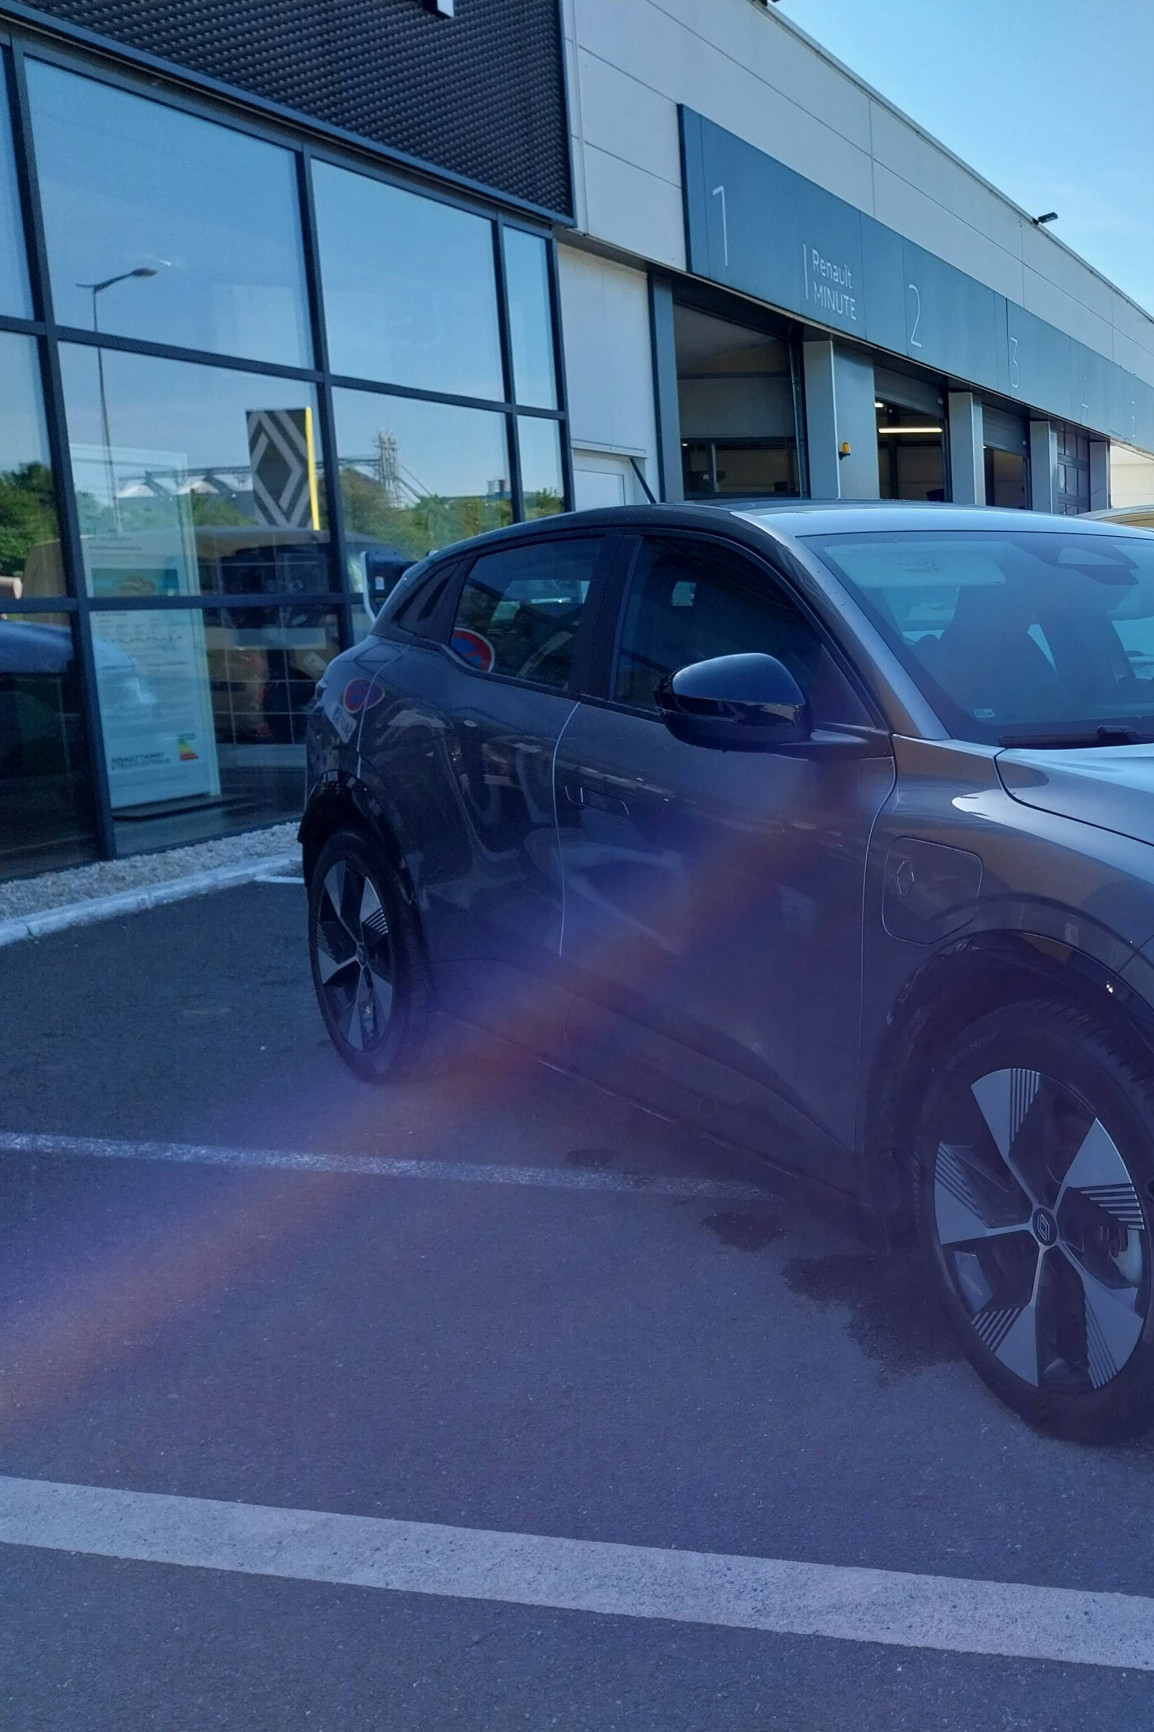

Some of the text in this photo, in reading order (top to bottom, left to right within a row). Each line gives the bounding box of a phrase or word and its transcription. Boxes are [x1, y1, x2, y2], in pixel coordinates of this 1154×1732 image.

[712, 185, 728, 266] 1
[812, 248, 852, 289] Renault
[813, 281, 857, 320] MINUTE
[909, 284, 922, 348] 2
[1011, 337, 1020, 388] 3
